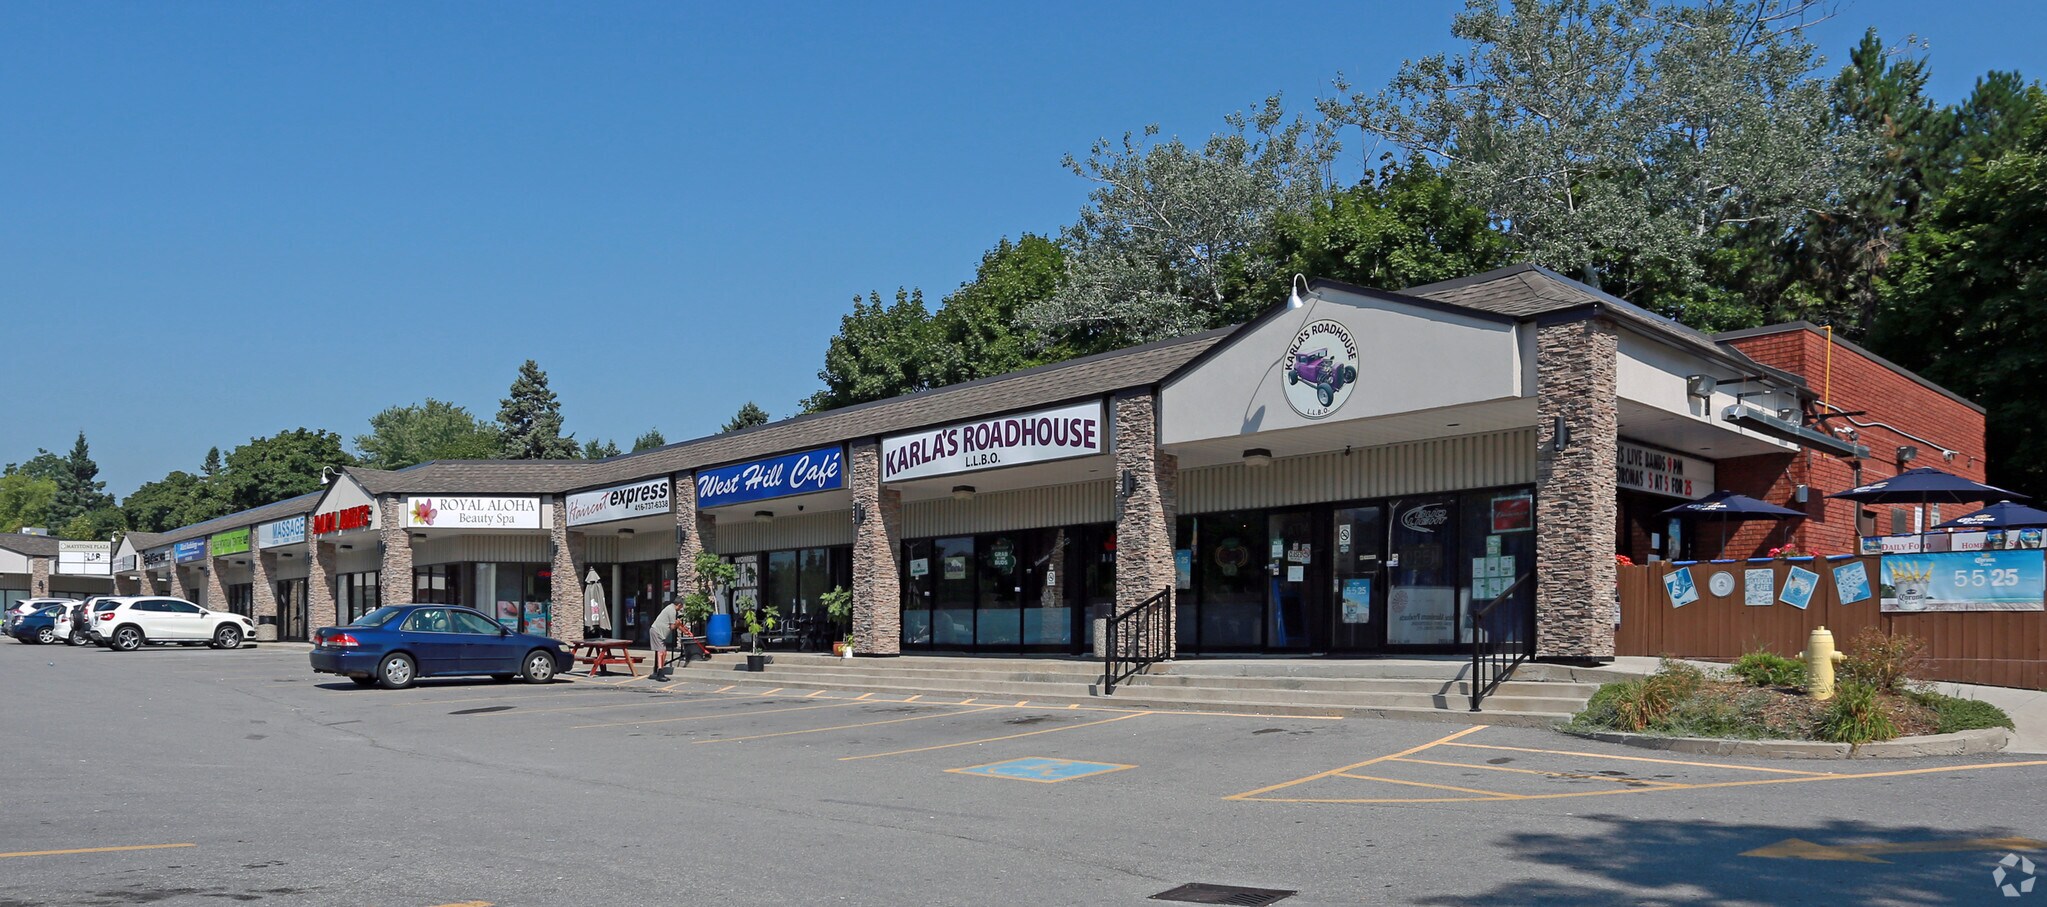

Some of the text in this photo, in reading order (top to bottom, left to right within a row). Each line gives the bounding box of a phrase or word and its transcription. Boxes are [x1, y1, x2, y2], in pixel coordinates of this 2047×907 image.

[1284, 323, 1357, 371] KARLA'S ROADHOUSE
[885, 417, 1096, 478] KARLA'S ROADHOUSE
[965, 452, 1001, 468] L.L.B.O.
[1627, 448, 1643, 466] LIVE
[1645, 452, 1665, 472] BANDS
[1667, 456, 1673, 473] 9
[1673, 458, 1684, 476] PM
[698, 452, 841, 498] West Hill Café
[1648, 471, 1653, 489] 5
[1654, 474, 1663, 491] AT
[1664, 475, 1669, 492] 5
[1671, 477, 1683, 495] FOR
[1684, 479, 1692, 496] 25
[440, 499, 535, 512] ROYAL ALOHA
[568, 482, 668, 524] Haircut express
[634, 500, 669, 511] 416-737-6338
[459, 513, 515, 526] Beauty Spa
[272, 517, 304, 539] MASSAGE
[1881, 542, 1907, 552] DAILY
[734, 555, 757, 563] WOMEN
[1974, 556, 1996, 564] Corona
[1898, 592, 1924, 601] Corona
